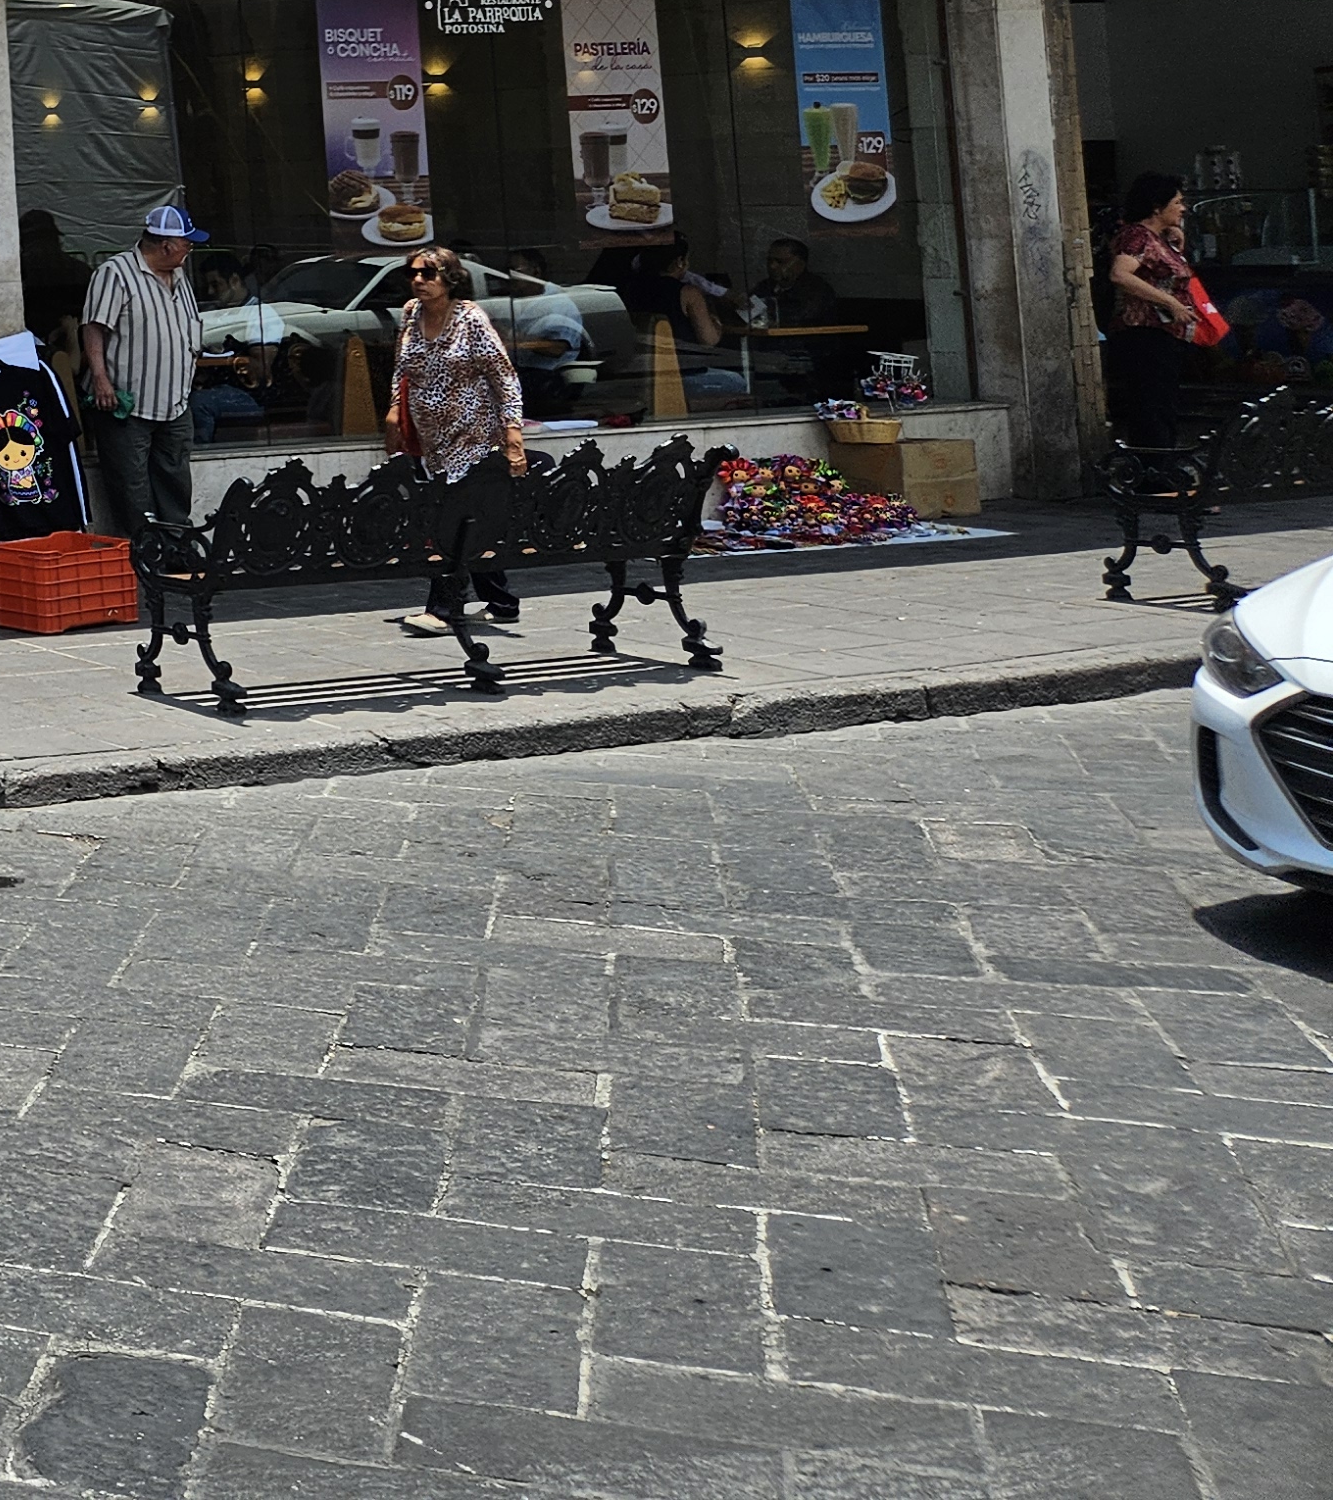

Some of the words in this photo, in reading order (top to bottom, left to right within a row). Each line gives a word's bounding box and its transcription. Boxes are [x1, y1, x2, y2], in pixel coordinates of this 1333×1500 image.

[443, 8, 463, 23] LA
[324, 28, 384, 43] BISQUET
[444, 24, 505, 34] POTOSINA
[797, 31, 875, 43] HAMBURGUESA
[336, 43, 401, 58] CONCHA
[573, 38, 651, 57] PASTELERÍA
[592, 56, 608, 71] de
[610, 56, 623, 71] la
[625, 63, 653, 71] casa
[815, 74, 830, 82] $20
[389, 84, 415, 101] $119
[632, 98, 658, 115] $129
[858, 137, 885, 154] $129
